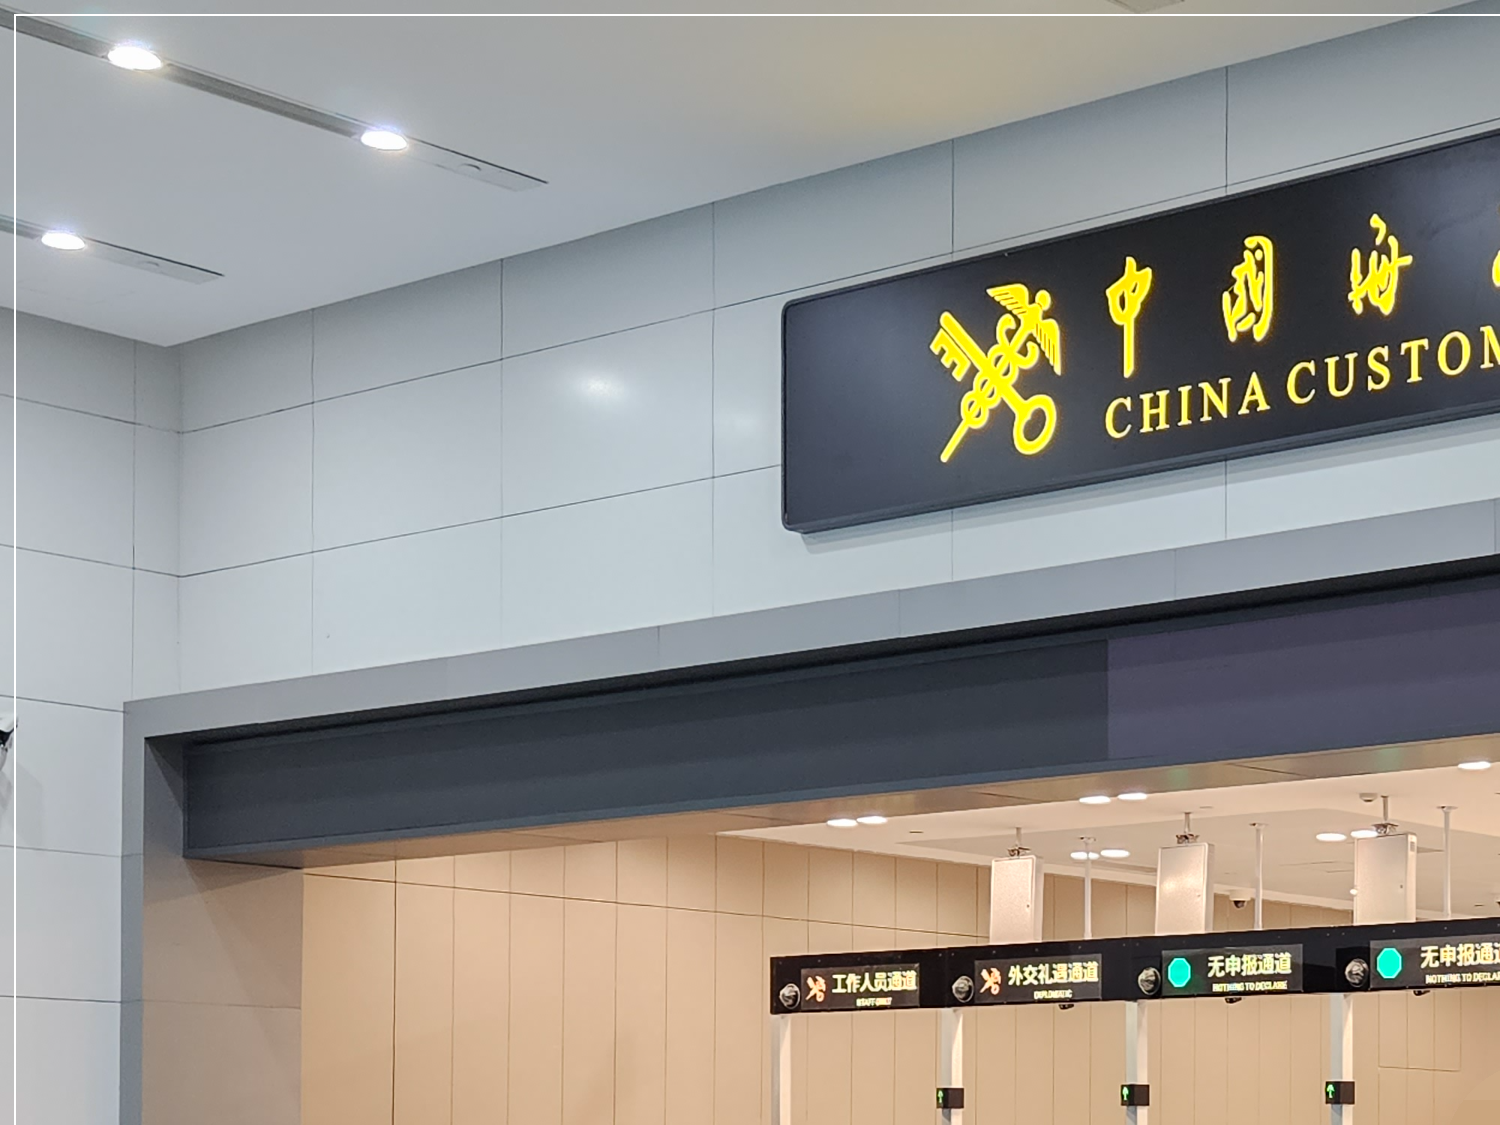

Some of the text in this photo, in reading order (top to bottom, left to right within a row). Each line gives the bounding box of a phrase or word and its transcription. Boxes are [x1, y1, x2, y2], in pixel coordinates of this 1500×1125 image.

[1105, 372, 1271, 439] CHINA
[1008, 961, 1099, 987] 外交礼遇通道
[1207, 952, 1292, 978] 无申报通道
[831, 970, 918, 994] 工作人员通道
